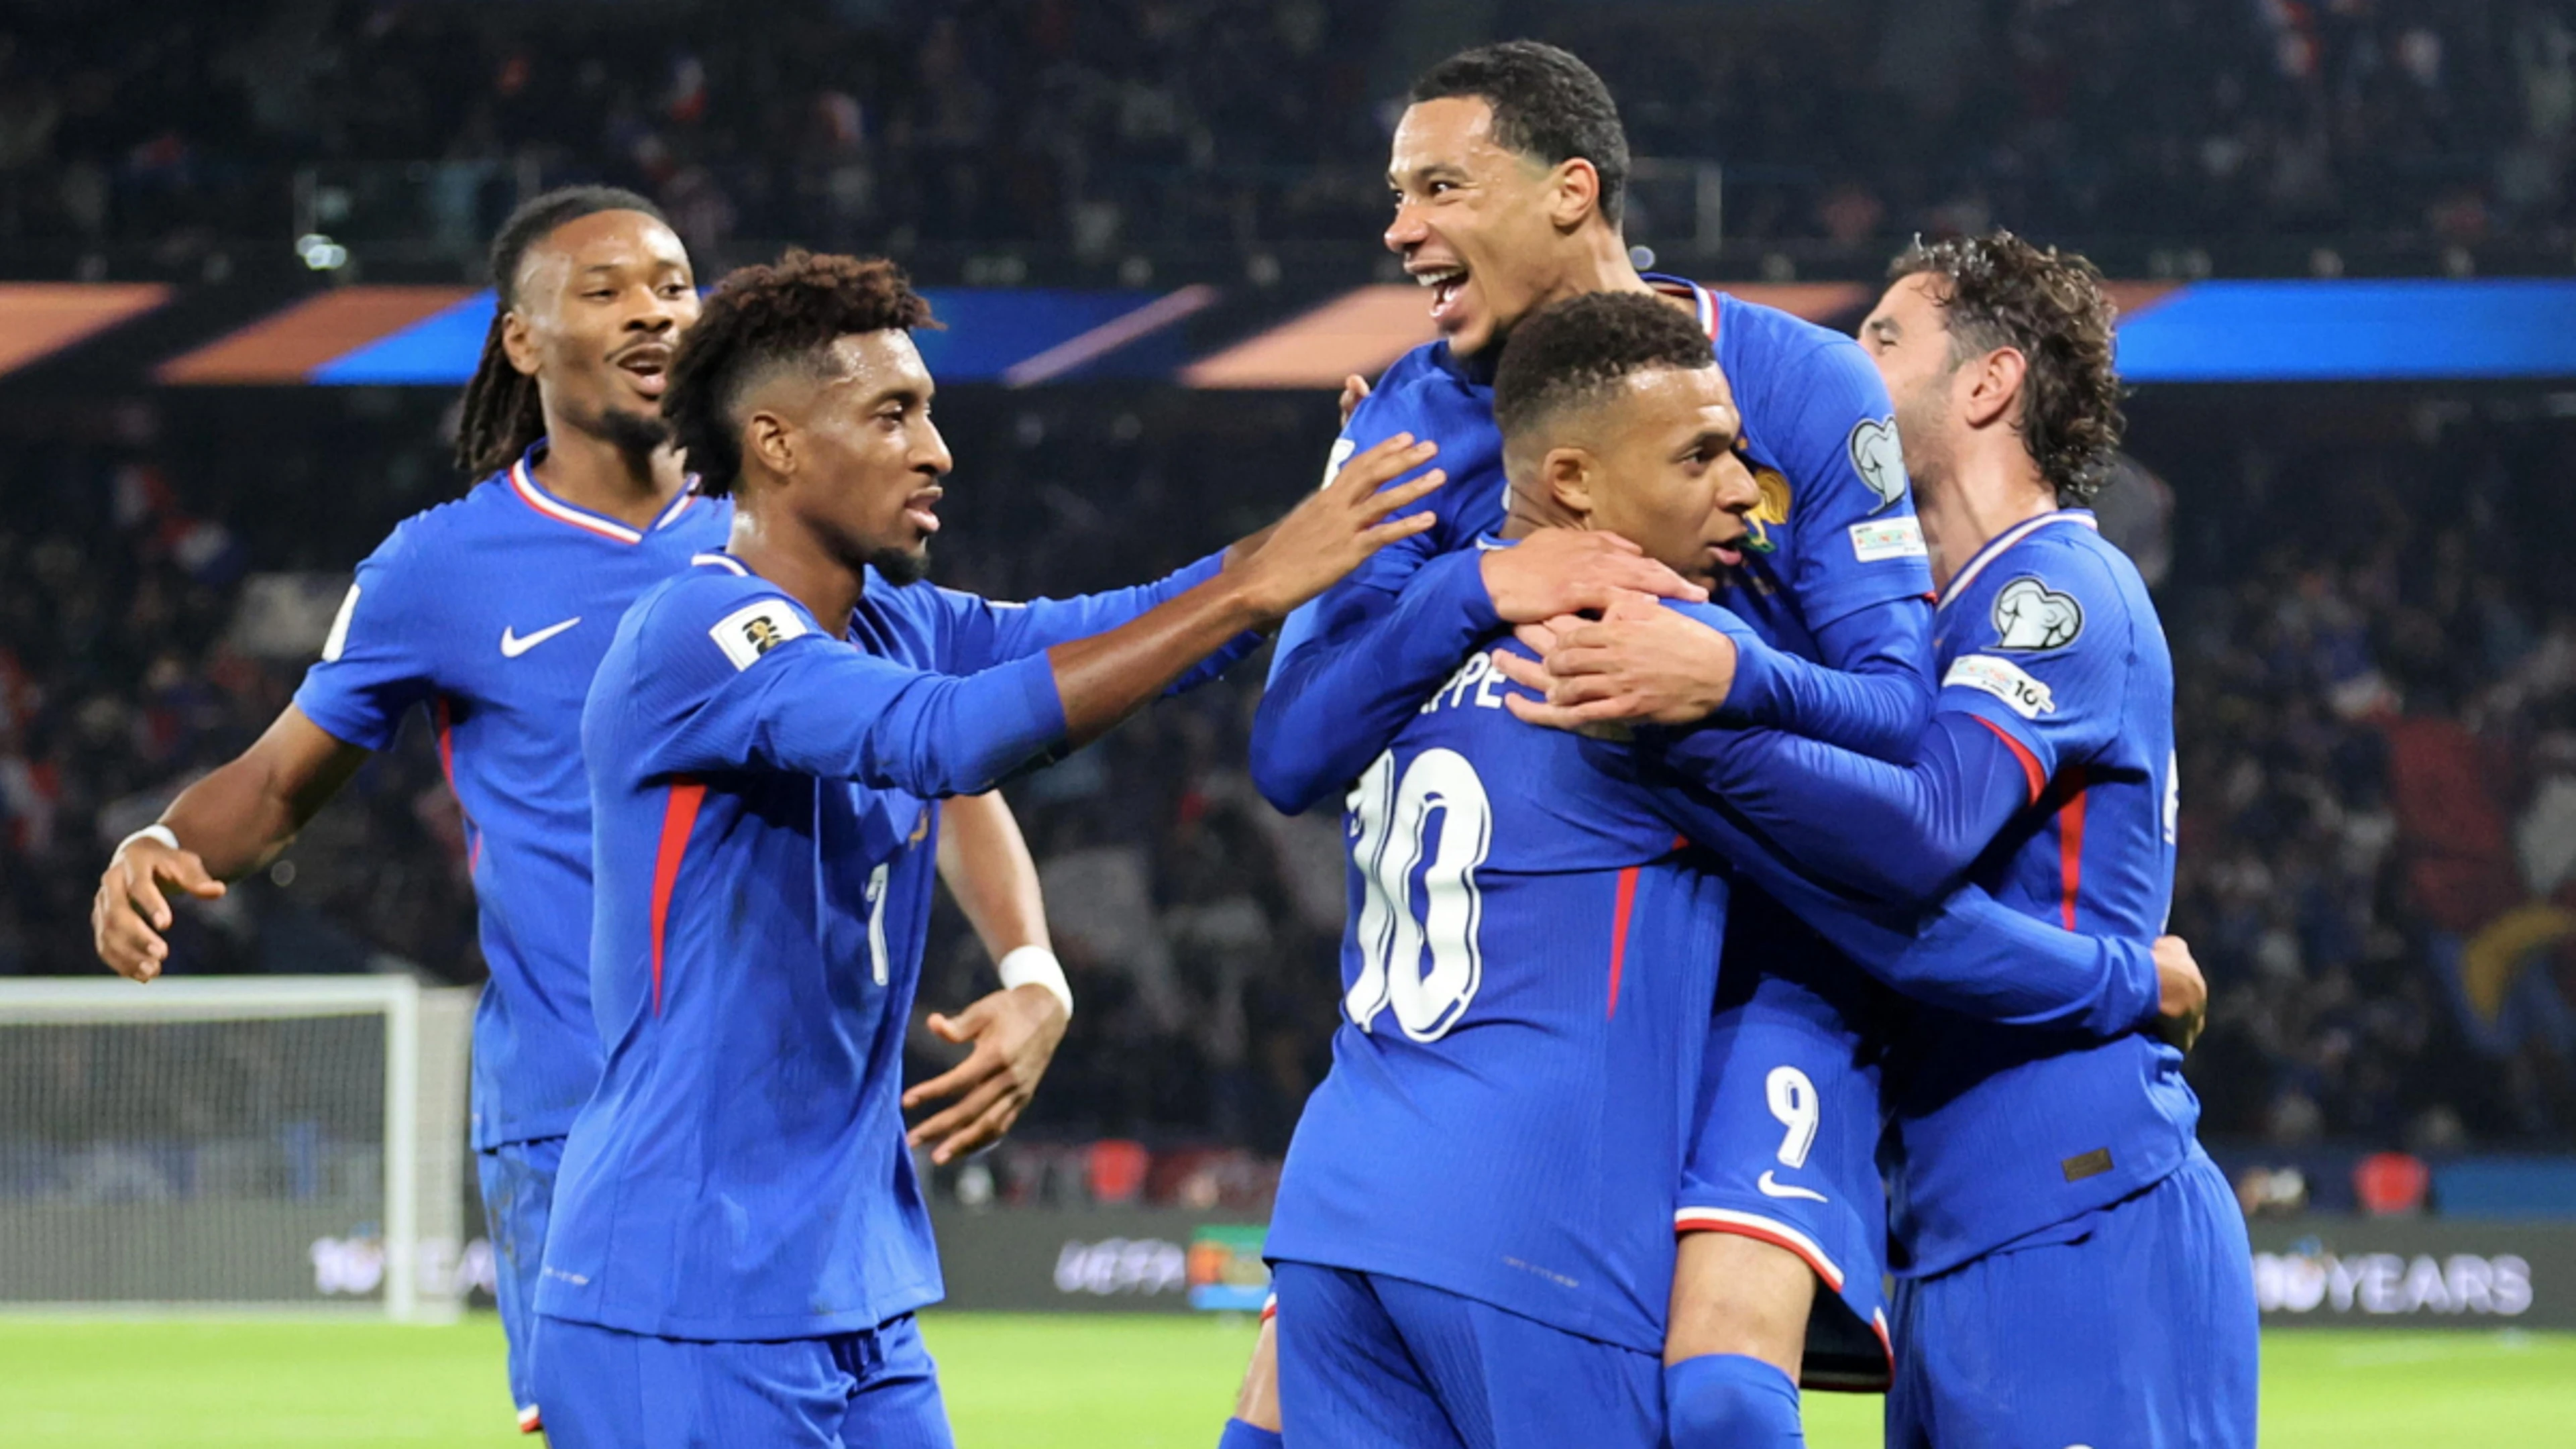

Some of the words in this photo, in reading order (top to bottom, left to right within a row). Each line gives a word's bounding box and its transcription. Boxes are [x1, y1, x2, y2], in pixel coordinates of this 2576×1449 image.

[1345, 747, 1493, 1043] 10
[1766, 1065, 1820, 1169] 9
[1054, 1237, 1185, 1296] UEFA
[2328, 1252, 2533, 1315] YEARS
